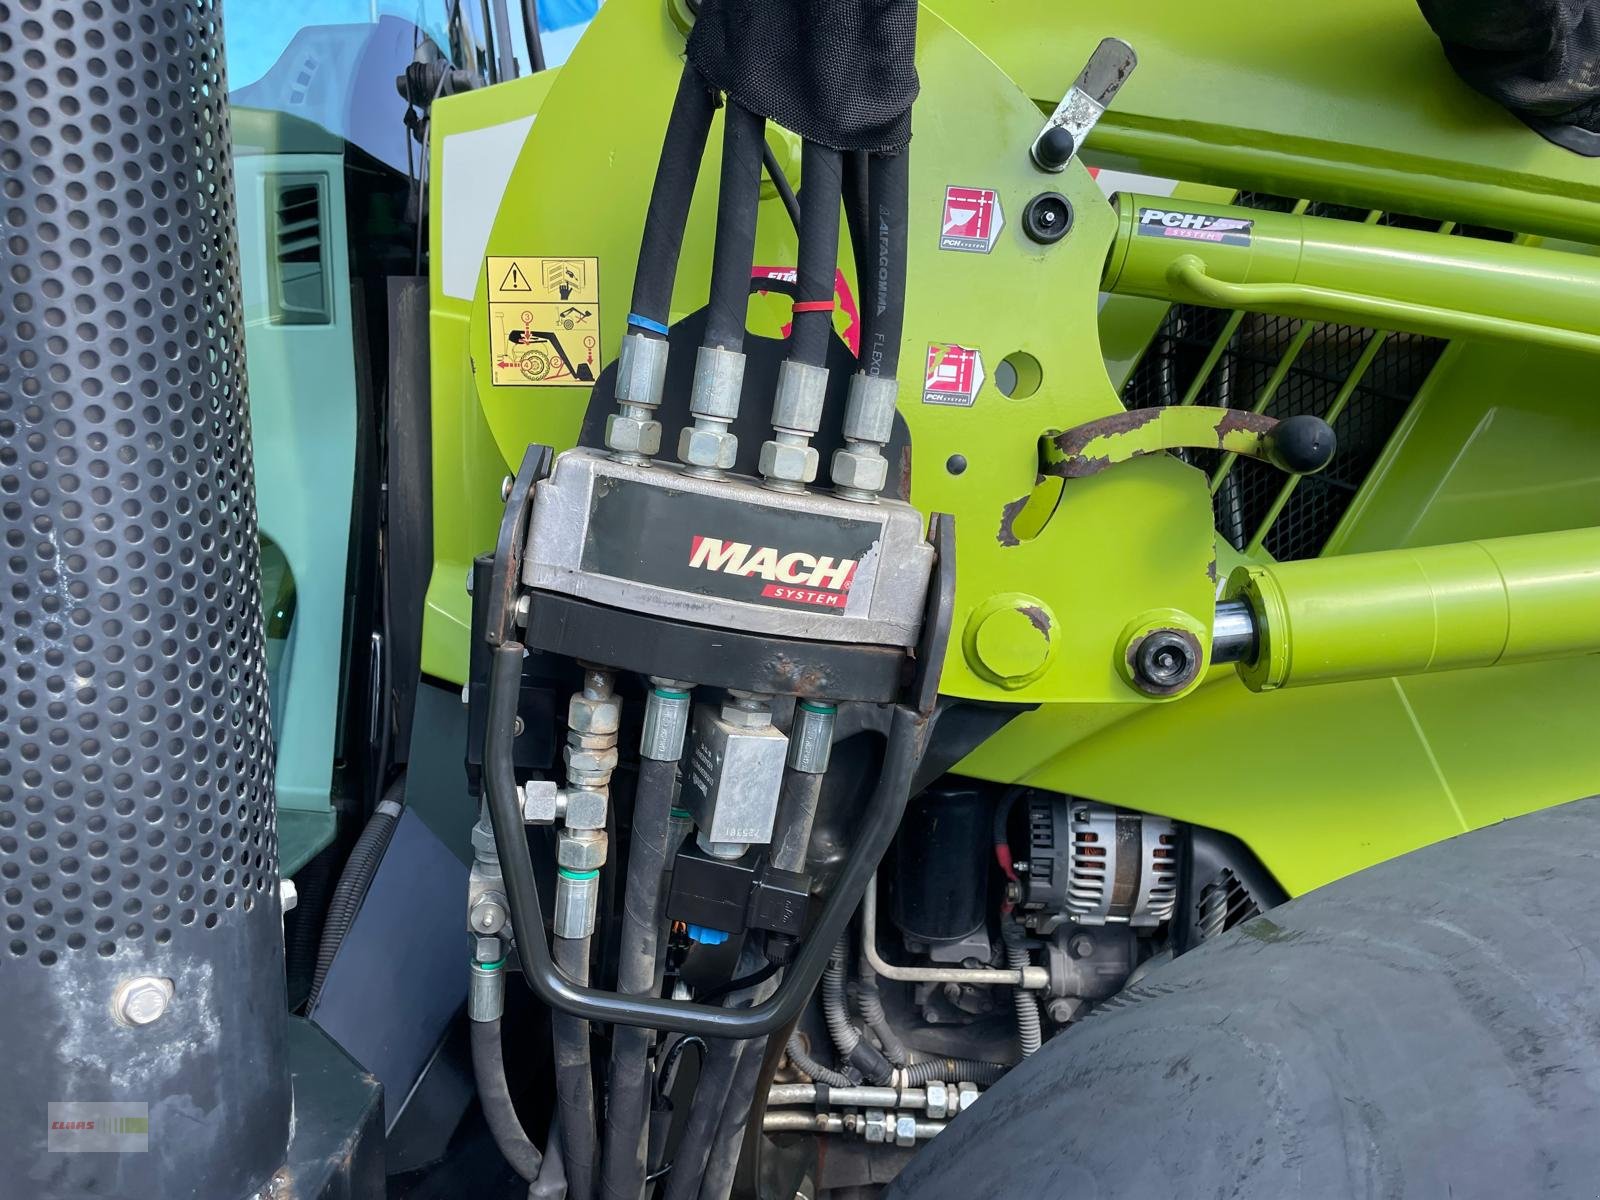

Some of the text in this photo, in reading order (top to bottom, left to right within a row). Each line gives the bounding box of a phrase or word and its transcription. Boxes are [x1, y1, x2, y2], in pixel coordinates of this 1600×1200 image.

[943, 239, 961, 247] PCH
[1173, 229, 1215, 240] SYSTEM
[878, 216, 889, 317] ALFAGOMMA
[870, 332, 885, 379] FLEXO
[688, 536, 857, 590] MACH
[774, 588, 838, 605] SYSTEM
